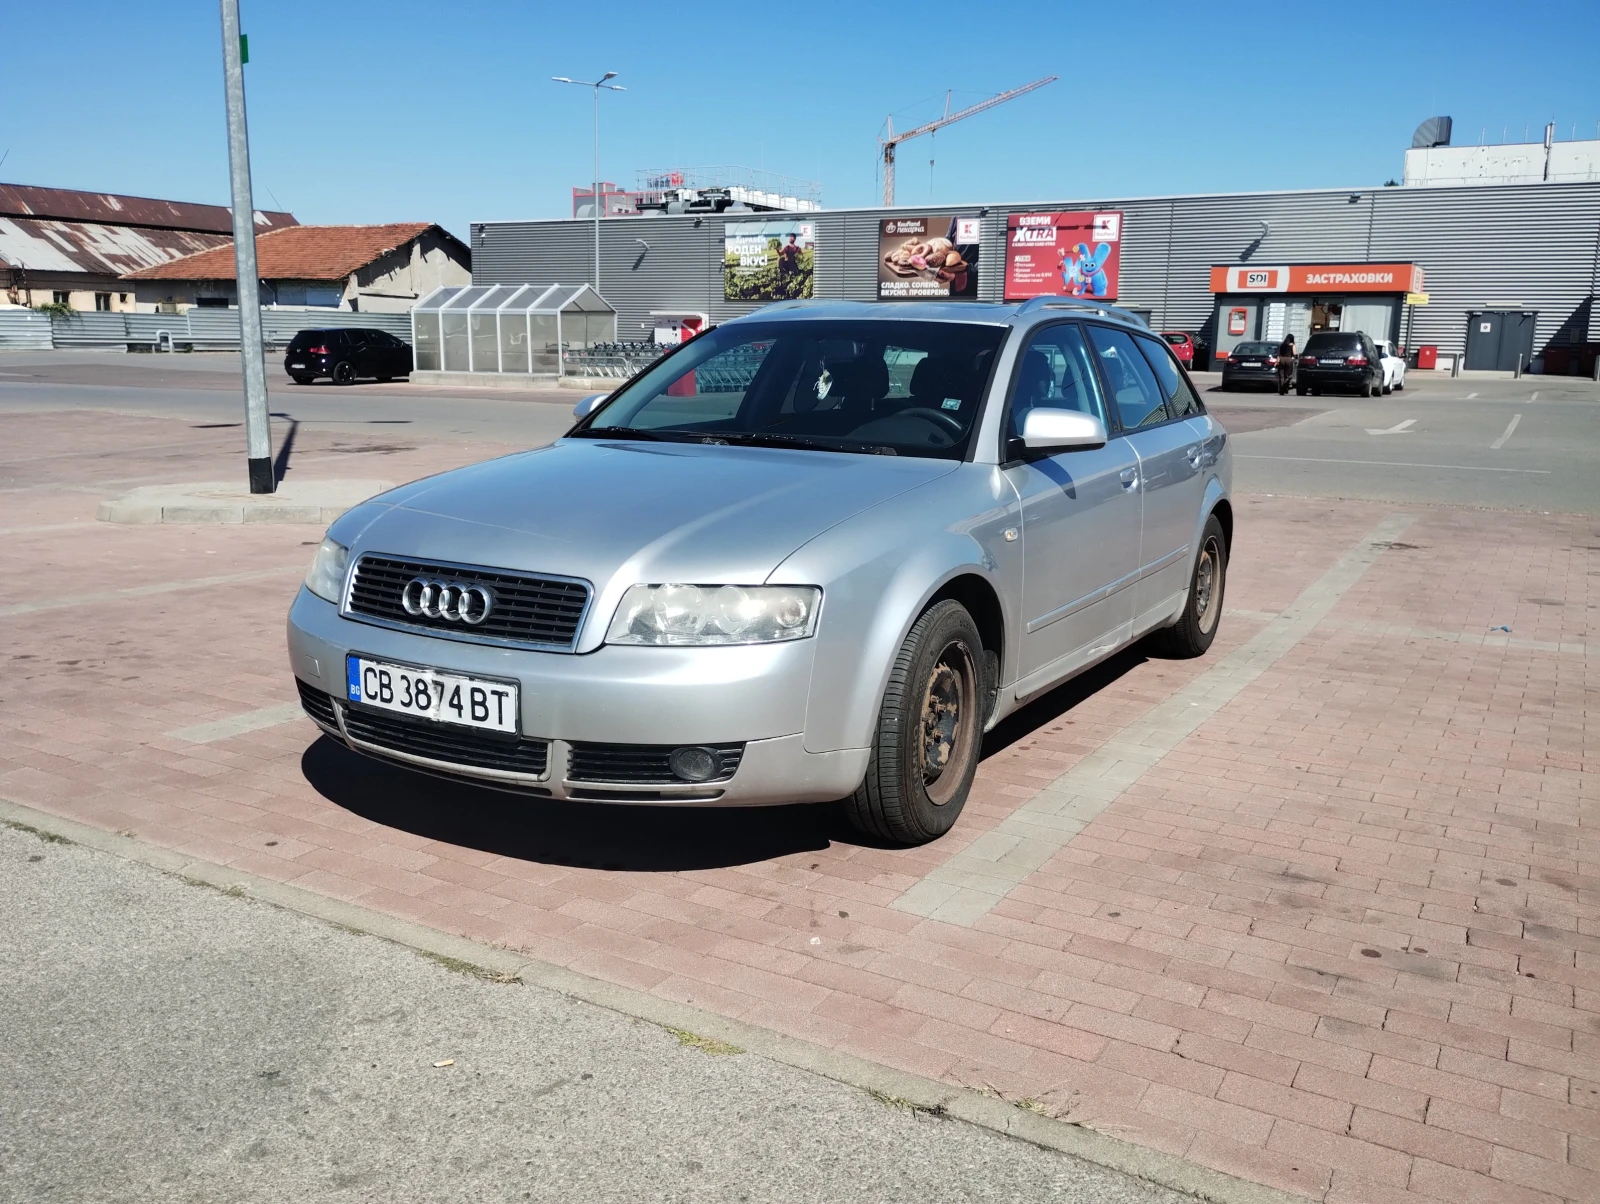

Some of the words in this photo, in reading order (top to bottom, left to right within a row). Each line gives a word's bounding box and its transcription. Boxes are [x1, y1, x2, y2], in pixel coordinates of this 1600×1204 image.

[1019, 215, 1051, 226] ВЗЕМИ
[727, 245, 762, 257] РОДЕН
[740, 254, 768, 267] ВКУС!
[1248, 274, 1267, 283] SDI
[1305, 272, 1393, 284] ЗАСТРАХОВКИ
[881, 281, 910, 290] СЛАДКО.
[911, 281, 940, 289] СОЛЕНО.
[350, 683, 361, 696] BG
[363, 666, 394, 704] CB
[400, 674, 464, 719] 3874
[470, 686, 510, 726] BT
